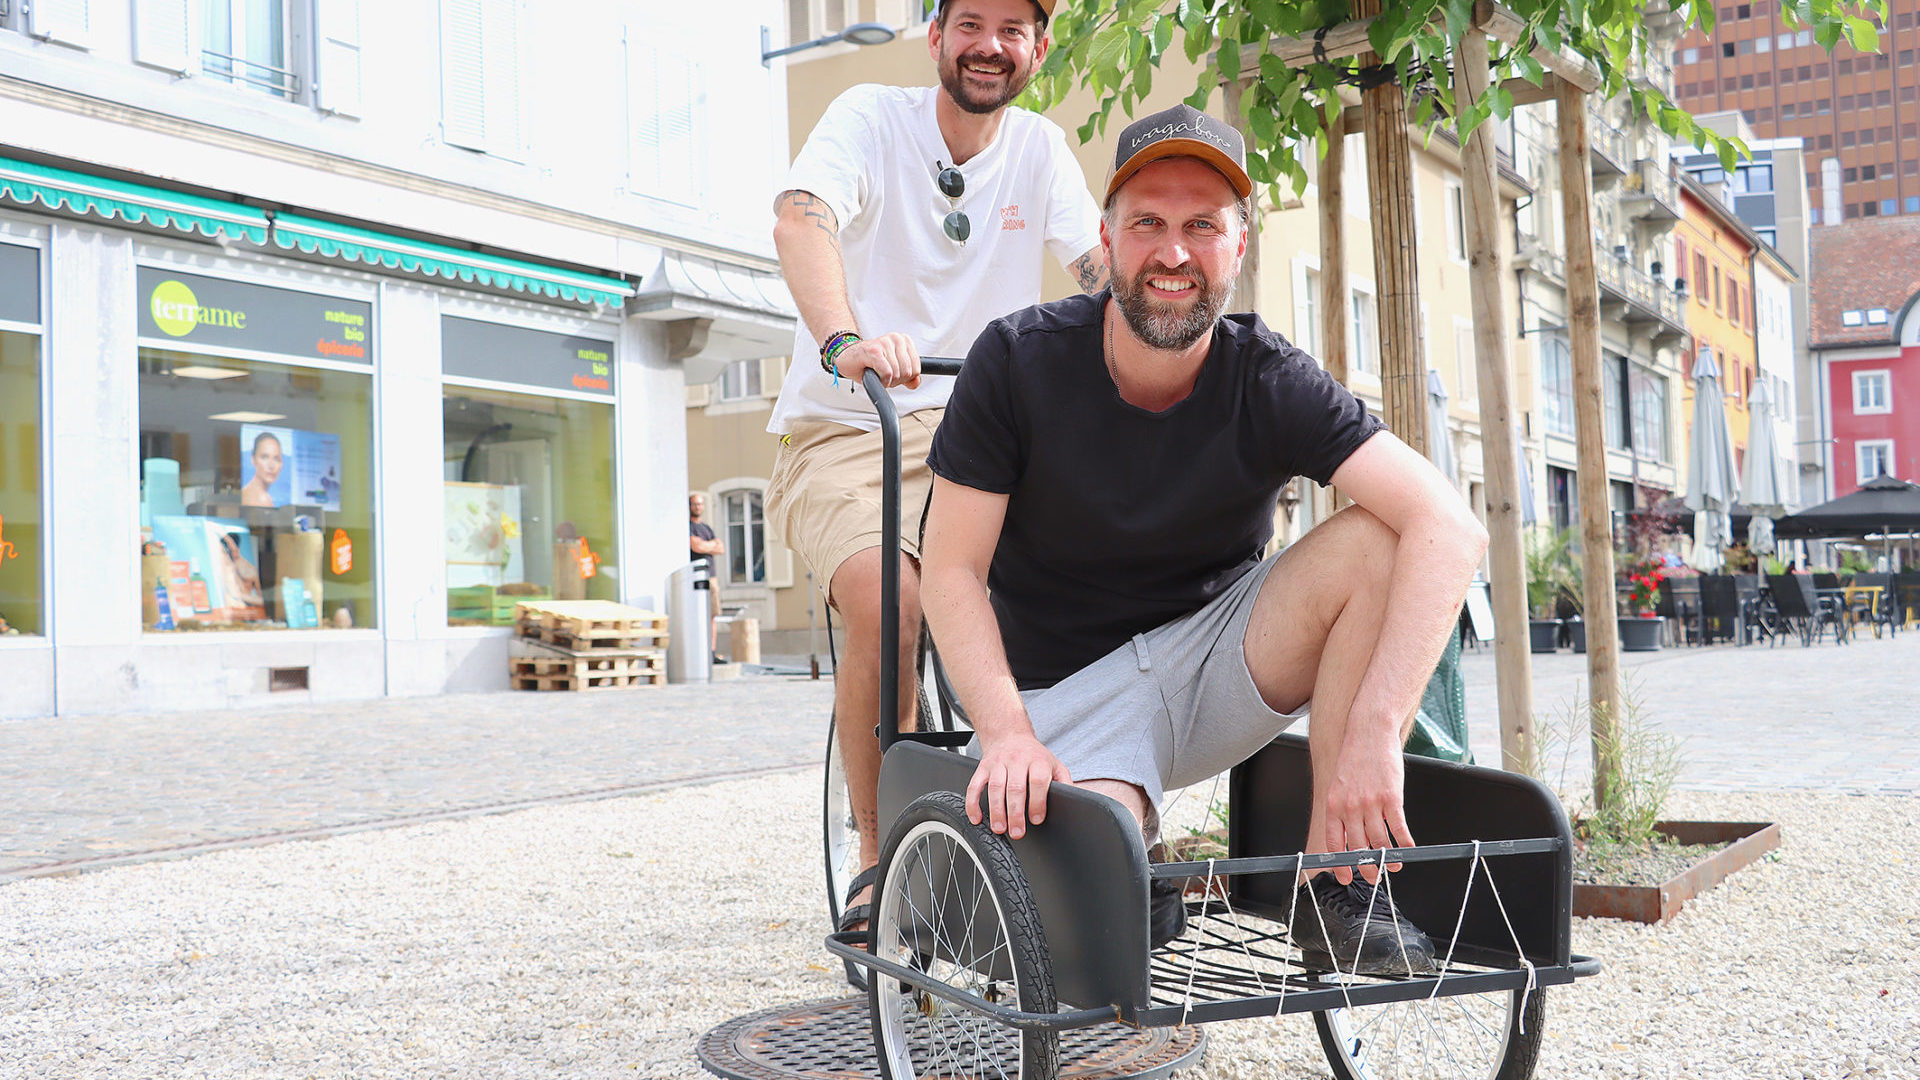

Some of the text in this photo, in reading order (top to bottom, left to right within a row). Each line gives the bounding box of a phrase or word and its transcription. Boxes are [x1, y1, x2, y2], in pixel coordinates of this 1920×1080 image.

[154, 298, 247, 329] terrame
[325, 311, 364, 326] nature
[344, 326, 364, 342] bio
[577, 349, 608, 362] nature
[592, 362, 608, 376] bio
